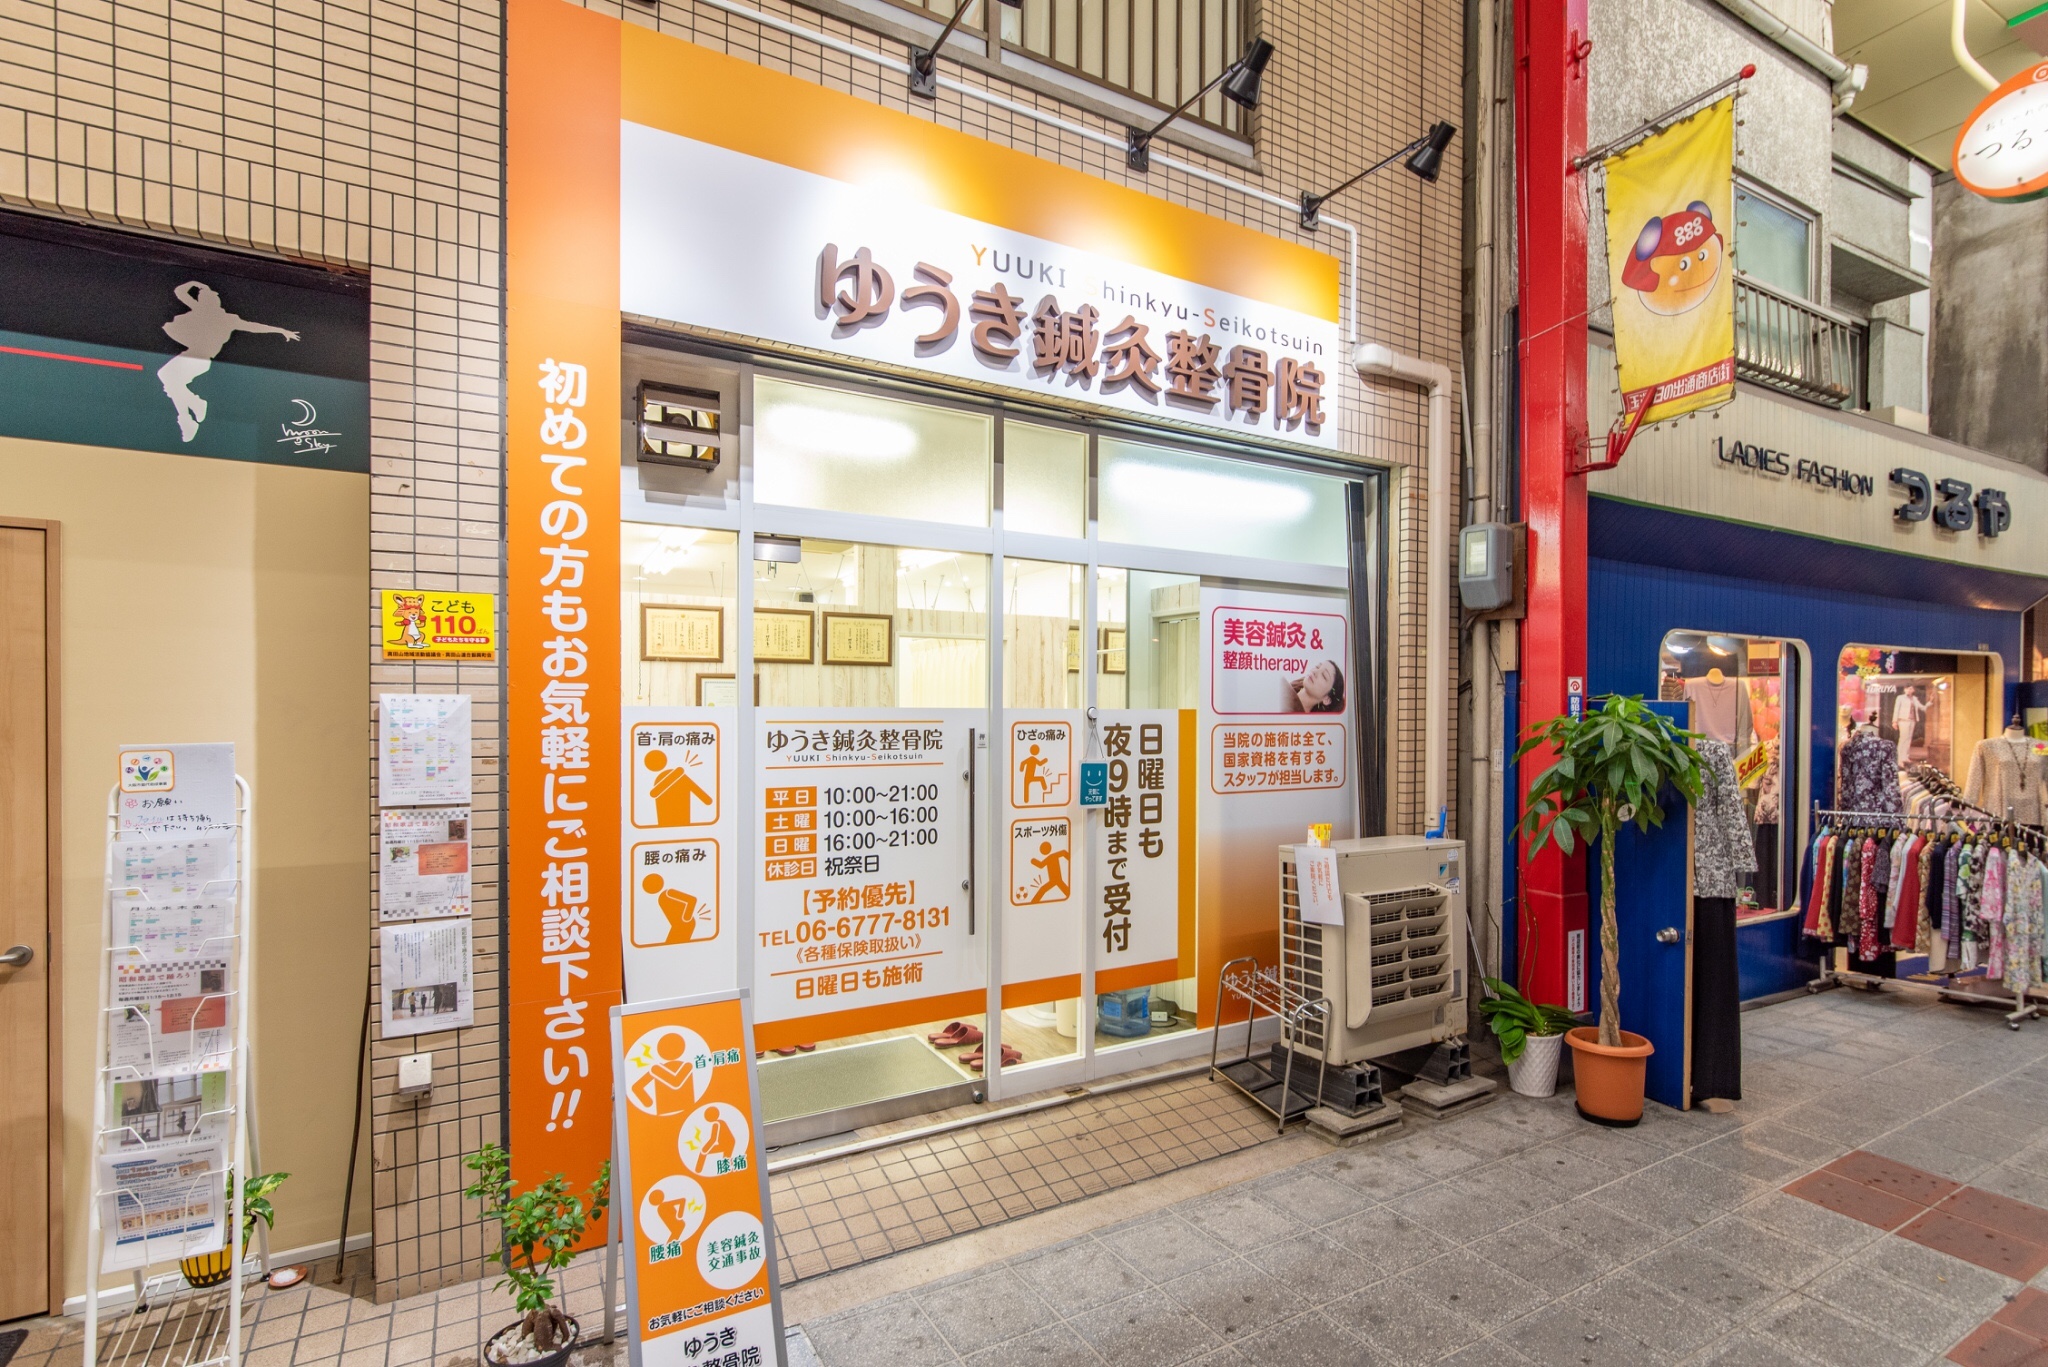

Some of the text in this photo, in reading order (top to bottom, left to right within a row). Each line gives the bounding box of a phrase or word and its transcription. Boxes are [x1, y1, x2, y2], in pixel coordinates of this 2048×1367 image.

[1974, 127, 2048, 160] つる
[970, 244, 1066, 288] YUUKI
[815, 243, 1326, 430] ゆうき鍼灸整骨院
[1628, 362, 1731, 410] 玉日の出通商店街
[1717, 436, 1874, 498] LADIES FASHION
[1889, 467, 2011, 538] つるや
[431, 600, 475, 614] こども
[430, 615, 477, 635] 110
[1223, 618, 1324, 650] 美容鍼灸 &
[1223, 650, 1308, 674] 整顔therapy
[636, 731, 716, 746] 首・肩の痛み
[767, 729, 943, 753] ゆうき鍼灸整骨院
[1016, 729, 1066, 741] ひざの痛み
[1223, 731, 1333, 748] 当院の施術は全て、
[786, 753, 923, 762] YUUKI Shinkyu-Seikotsuin
[1223, 750, 1326, 768] 国家資格を有する
[1738, 745, 1764, 781] SALE
[1223, 768, 1339, 787] スタッフが担当します。
[772, 789, 809, 805] 平日
[1138, 723, 1165, 858] 日曜日も
[142, 797, 183, 809] お願い
[772, 813, 810, 830] 土曜
[1014, 824, 1068, 839] スポーツ外傷
[773, 837, 810, 854] 日曜
[1103, 723, 1132, 953] 夜9時まで受付
[644, 848, 707, 865] 腰の痛み
[767, 855, 880, 878] 休診日 祝祭日
[803, 880, 915, 915] 【予約優先】
[795, 962, 923, 1000] 日曜日も施術
[693, 1048, 740, 1069] 首・肩痛
[716, 1154, 747, 1174] 膝痛
[650, 1241, 682, 1263] 腰痛
[707, 1231, 760, 1257] 美容鍼灸
[708, 1245, 762, 1272] 交通事故
[649, 1287, 764, 1330] お気軽にご相談ください
[684, 1326, 736, 1358] ゆうき
